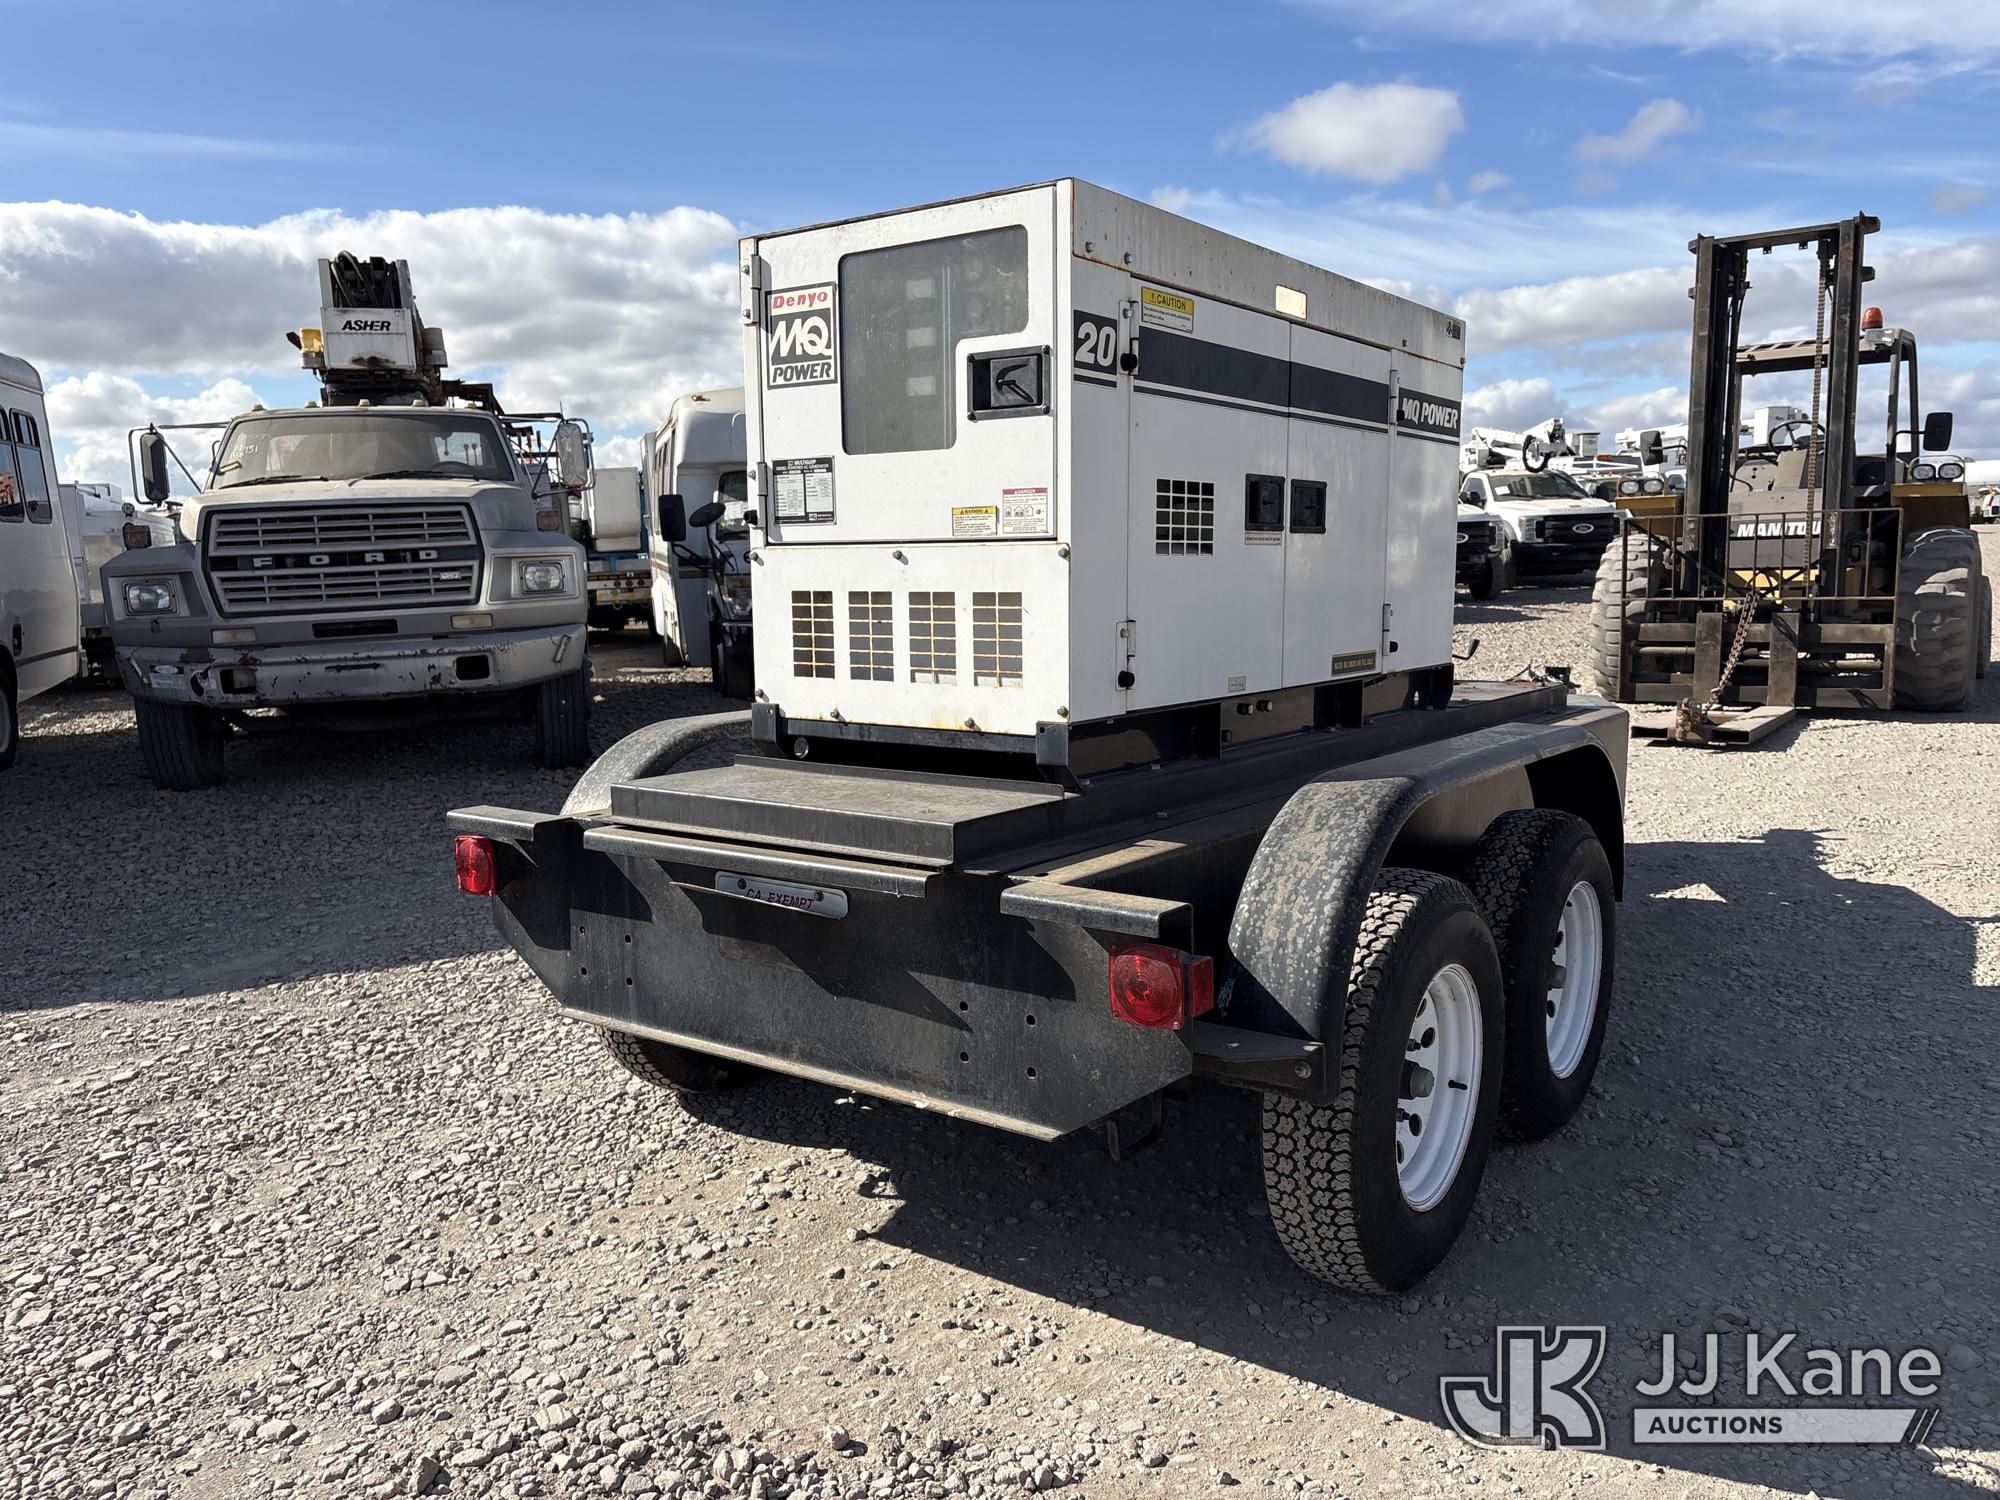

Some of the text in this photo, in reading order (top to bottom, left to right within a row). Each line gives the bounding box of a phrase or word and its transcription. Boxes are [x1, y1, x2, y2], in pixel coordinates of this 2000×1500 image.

[772, 291, 828, 309] Denyo
[1157, 294, 1187, 311] CAUTION
[341, 319, 391, 331] ASHER
[769, 316, 832, 358] MQ
[1075, 321, 1116, 366] 20
[772, 362, 832, 383] POWER
[1402, 398, 1459, 429] MQ POWER
[253, 550, 438, 567] FORD
[746, 888, 815, 910] CA EXEMPT
